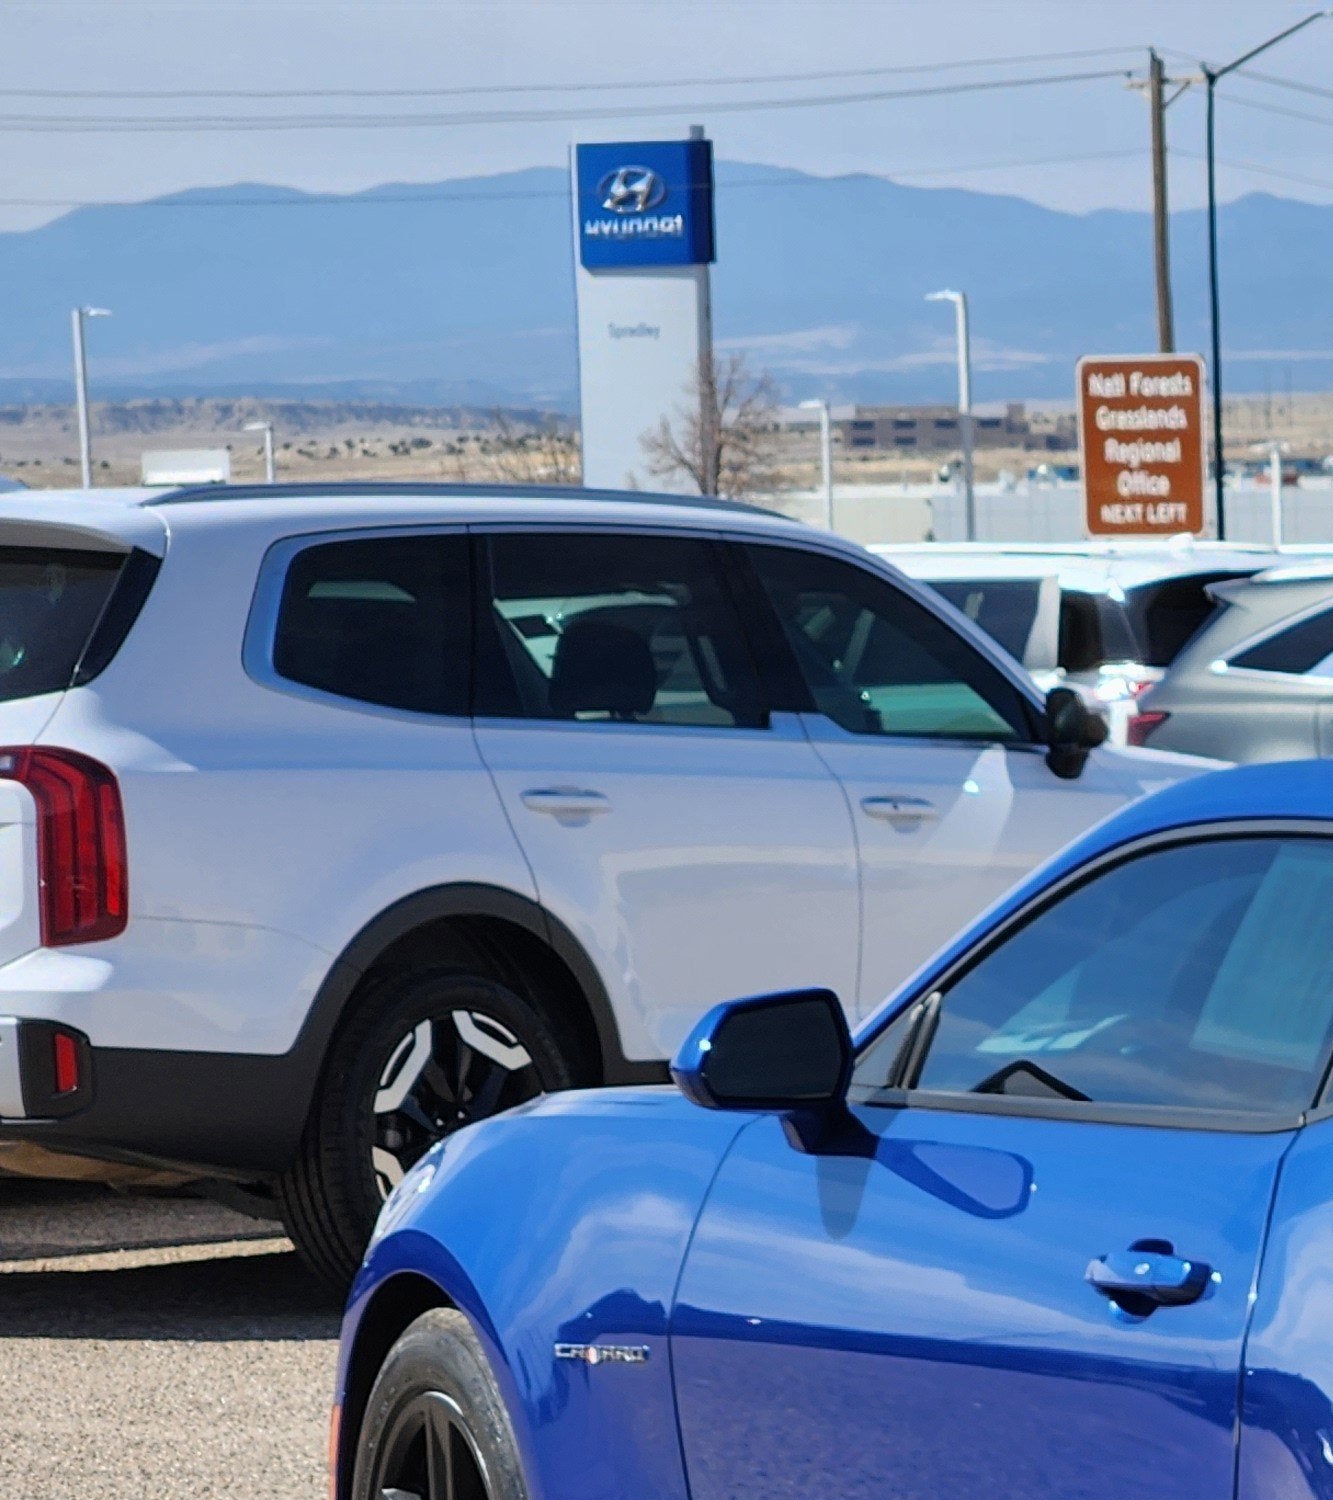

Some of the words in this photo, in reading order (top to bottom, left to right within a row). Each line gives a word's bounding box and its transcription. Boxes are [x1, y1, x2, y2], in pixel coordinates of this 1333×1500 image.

[1104, 436, 1182, 469] Regional
[1117, 469, 1171, 498] Office
[1100, 503, 1144, 524] NEXT
[1147, 502, 1188, 525] LEFT
[554, 1342, 651, 1365] CAARO
